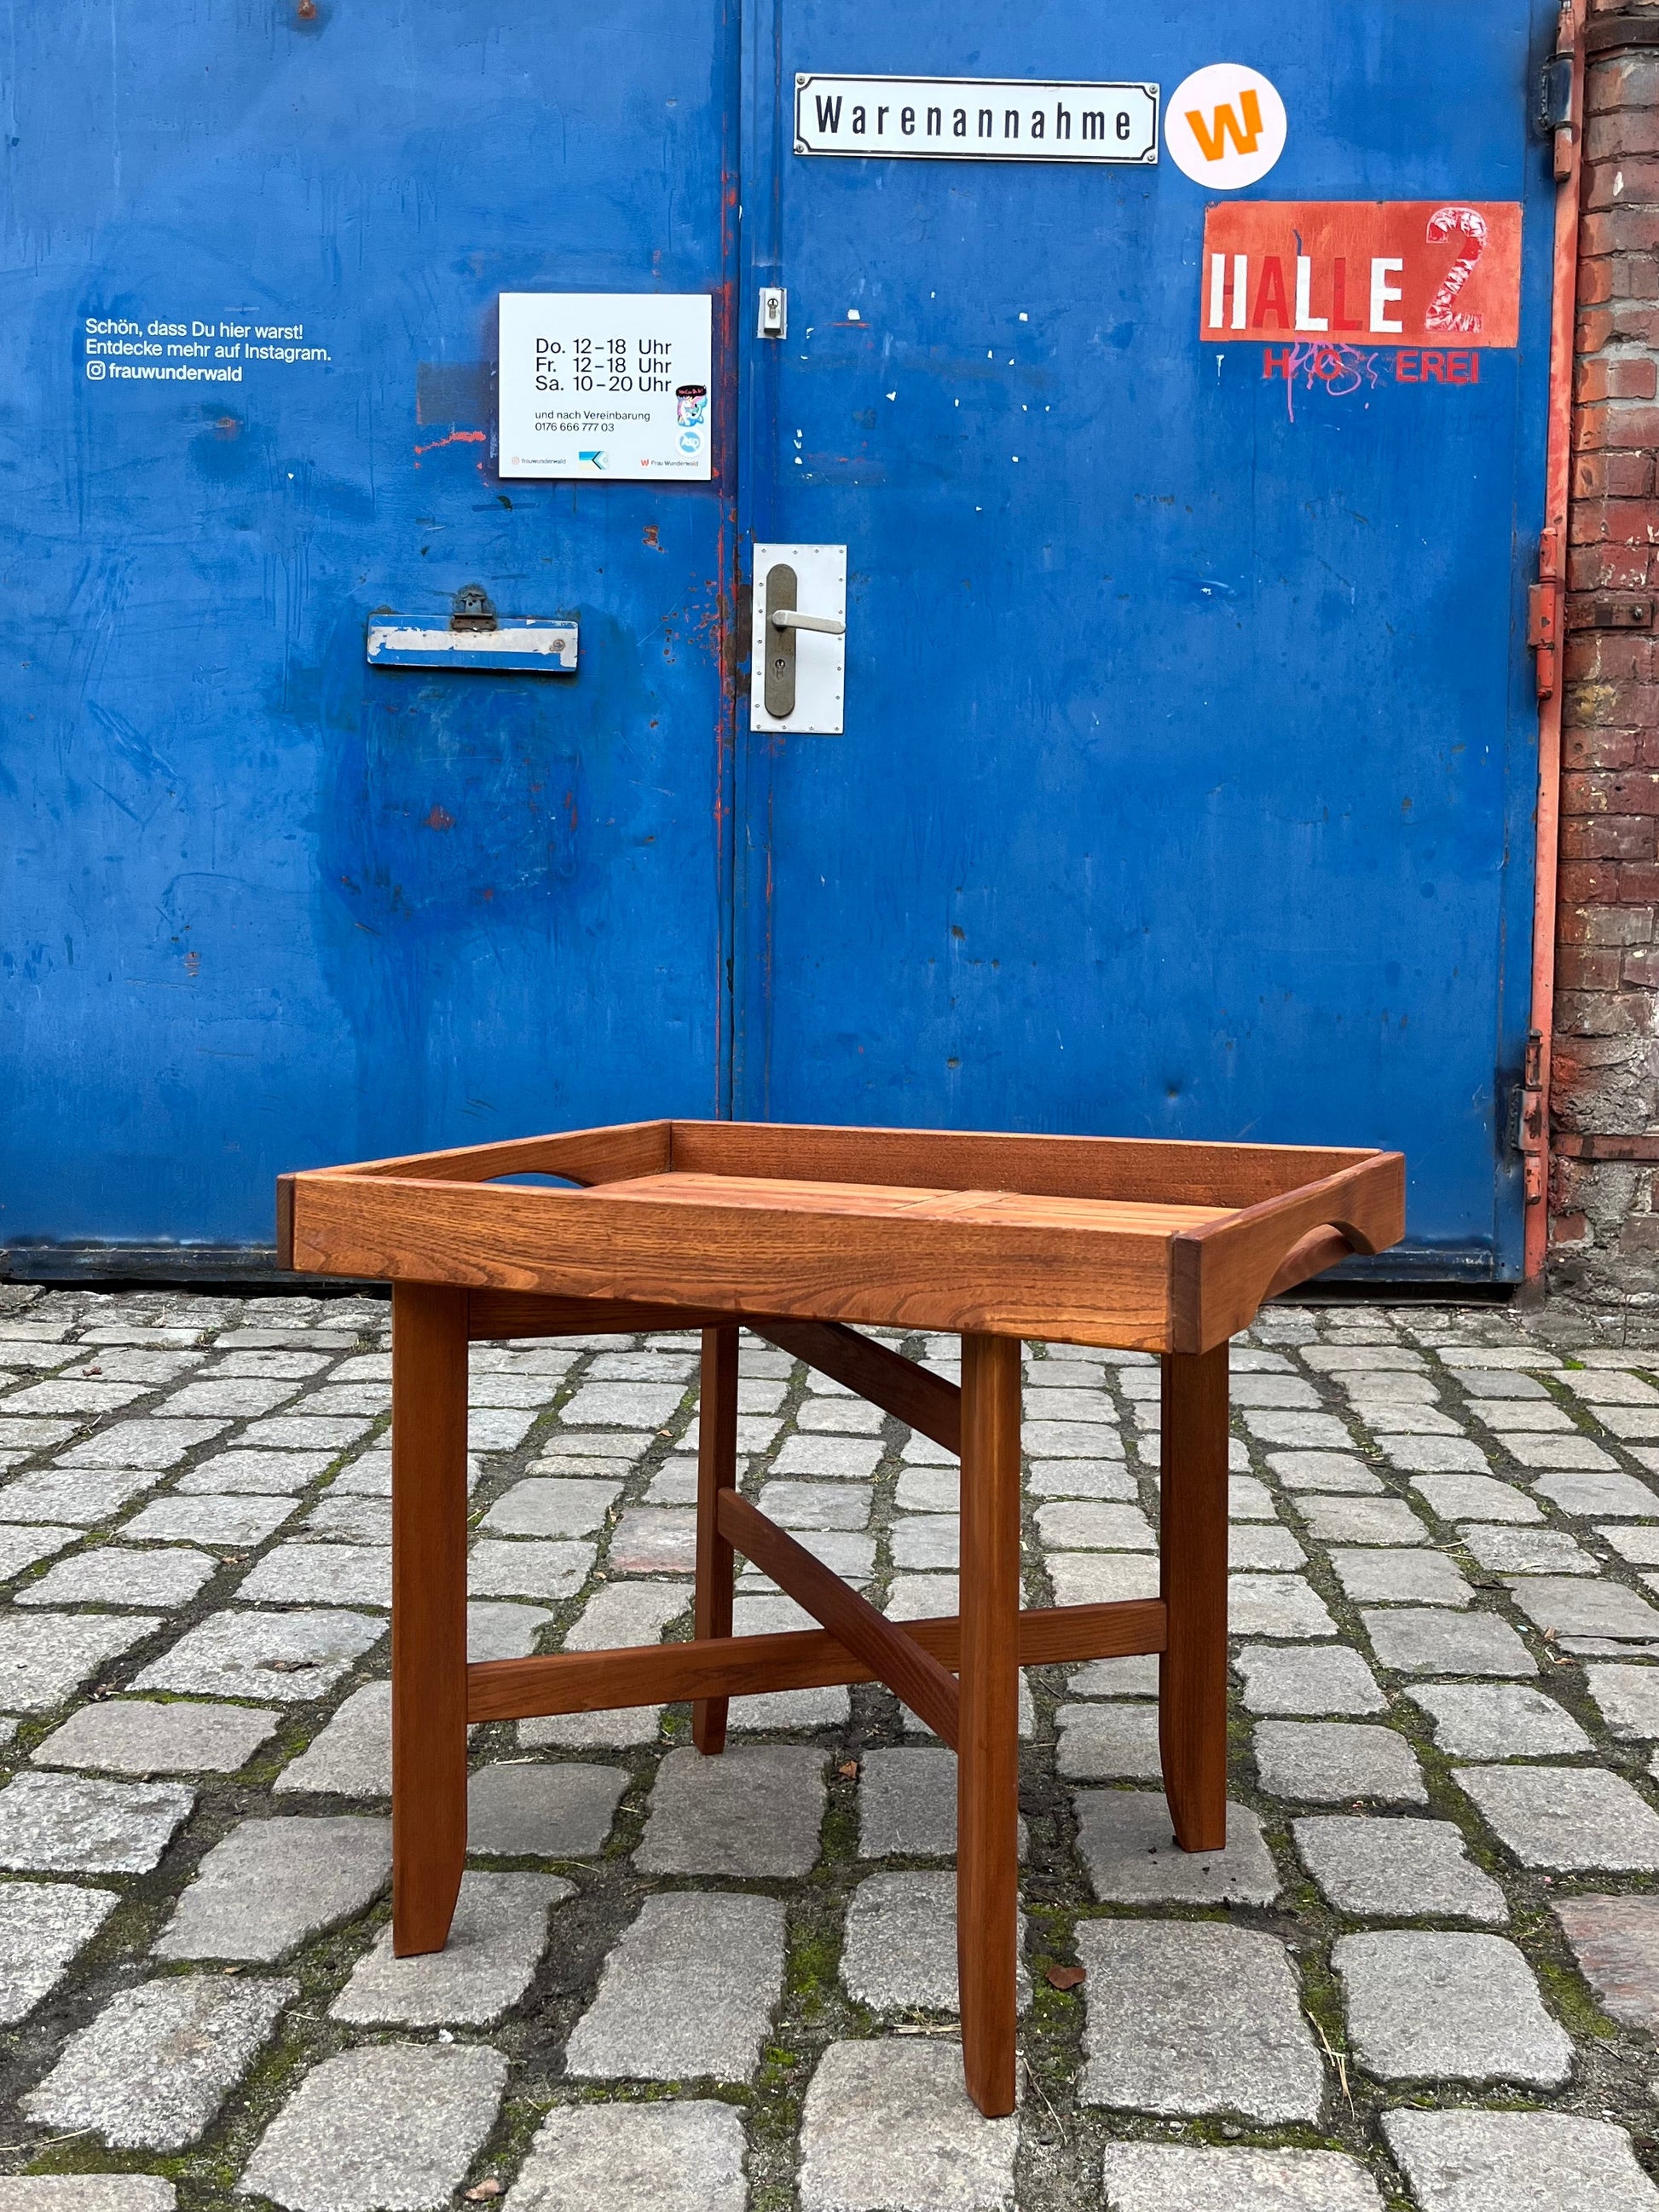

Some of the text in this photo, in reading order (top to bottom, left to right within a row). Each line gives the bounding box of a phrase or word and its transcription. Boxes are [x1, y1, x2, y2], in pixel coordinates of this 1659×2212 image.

[815, 95, 1130, 141] Warenannahme
[1208, 207, 1487, 333] HALLE 2
[85, 318, 303, 339] Schön, dass Du hier warst!
[85, 338, 332, 363] Entdecke mehr auf Instagram.
[536, 338, 566, 354] Do.
[639, 339, 672, 355] Uhr
[109, 363, 243, 382] frauwunderwald
[536, 357, 557, 373] Fr.
[639, 358, 672, 373] Uhr
[535, 375, 564, 391] Sa.
[639, 376, 672, 392] Uhr
[535, 410, 650, 422] und nach Vereinbarung
[535, 422, 615, 432] 0176 666 777 03
